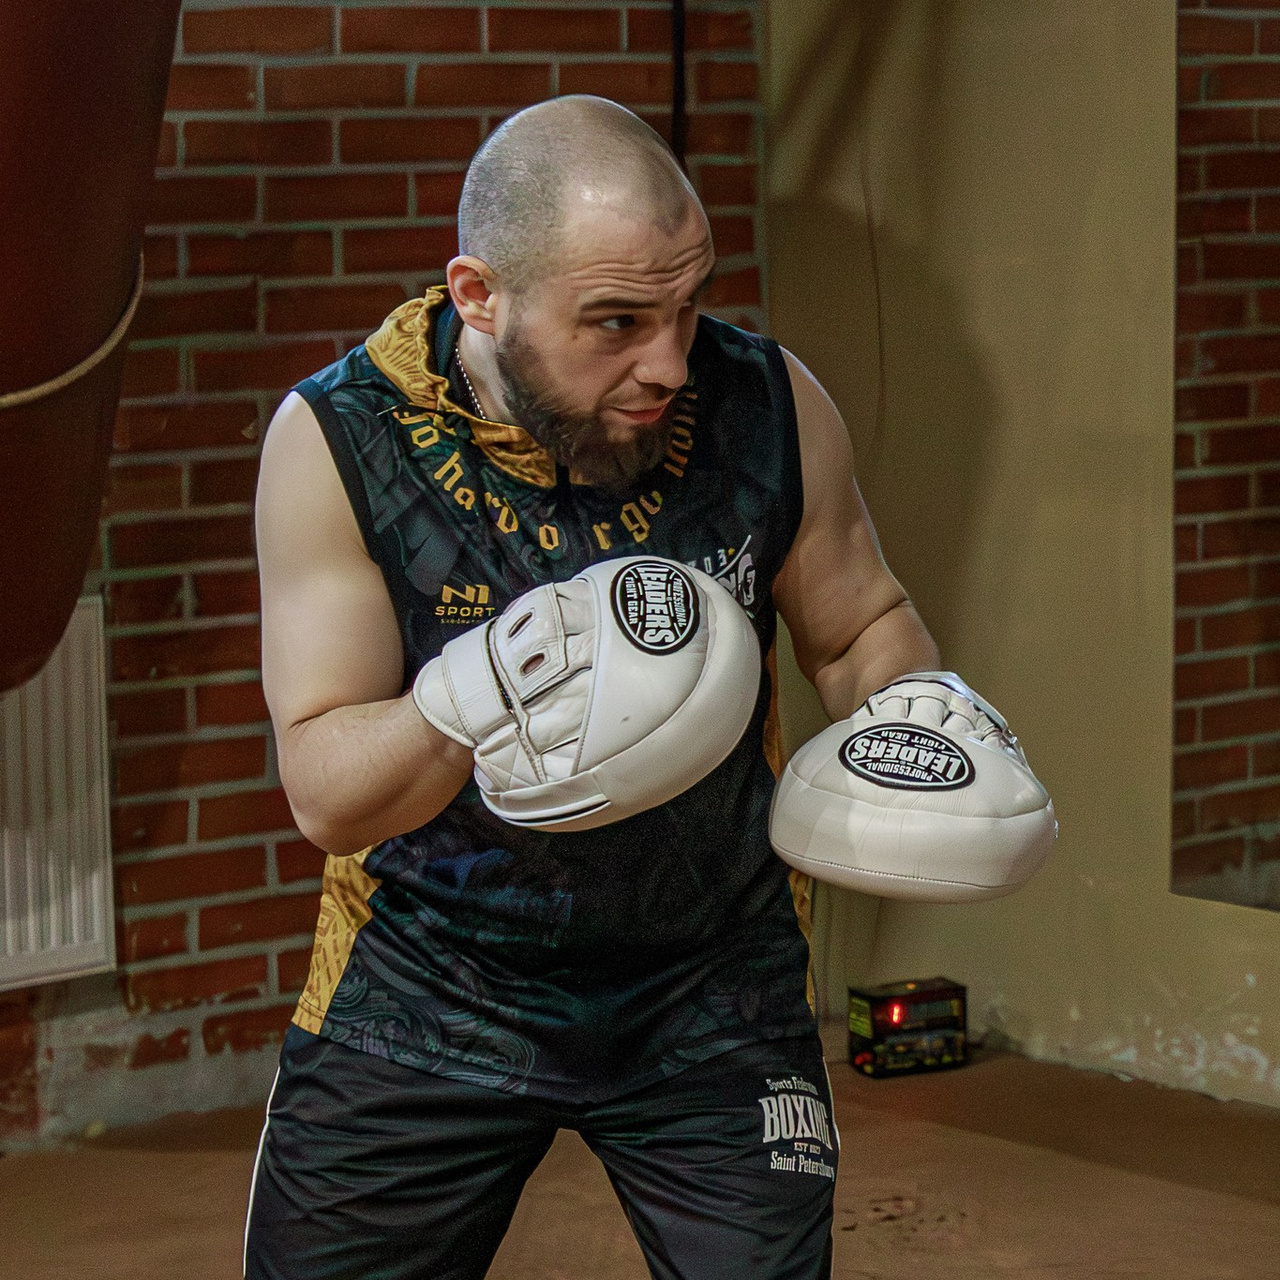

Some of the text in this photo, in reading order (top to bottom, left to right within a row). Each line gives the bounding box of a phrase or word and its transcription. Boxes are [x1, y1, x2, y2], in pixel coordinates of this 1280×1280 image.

[435, 606, 495, 617] SPORT
[625, 577, 639, 625] FIGHT GEAR
[636, 567, 675, 643] LEADERS
[673, 577, 687, 628] PROFESSIONAL
[881, 730, 946, 750] FIGHT GEAR
[851, 738, 961, 780] LEADERS
[866, 762, 933, 782] PROFESSIONAL
[766, 1079, 793, 1092] Sports
[770, 1151, 796, 1172] Saint
